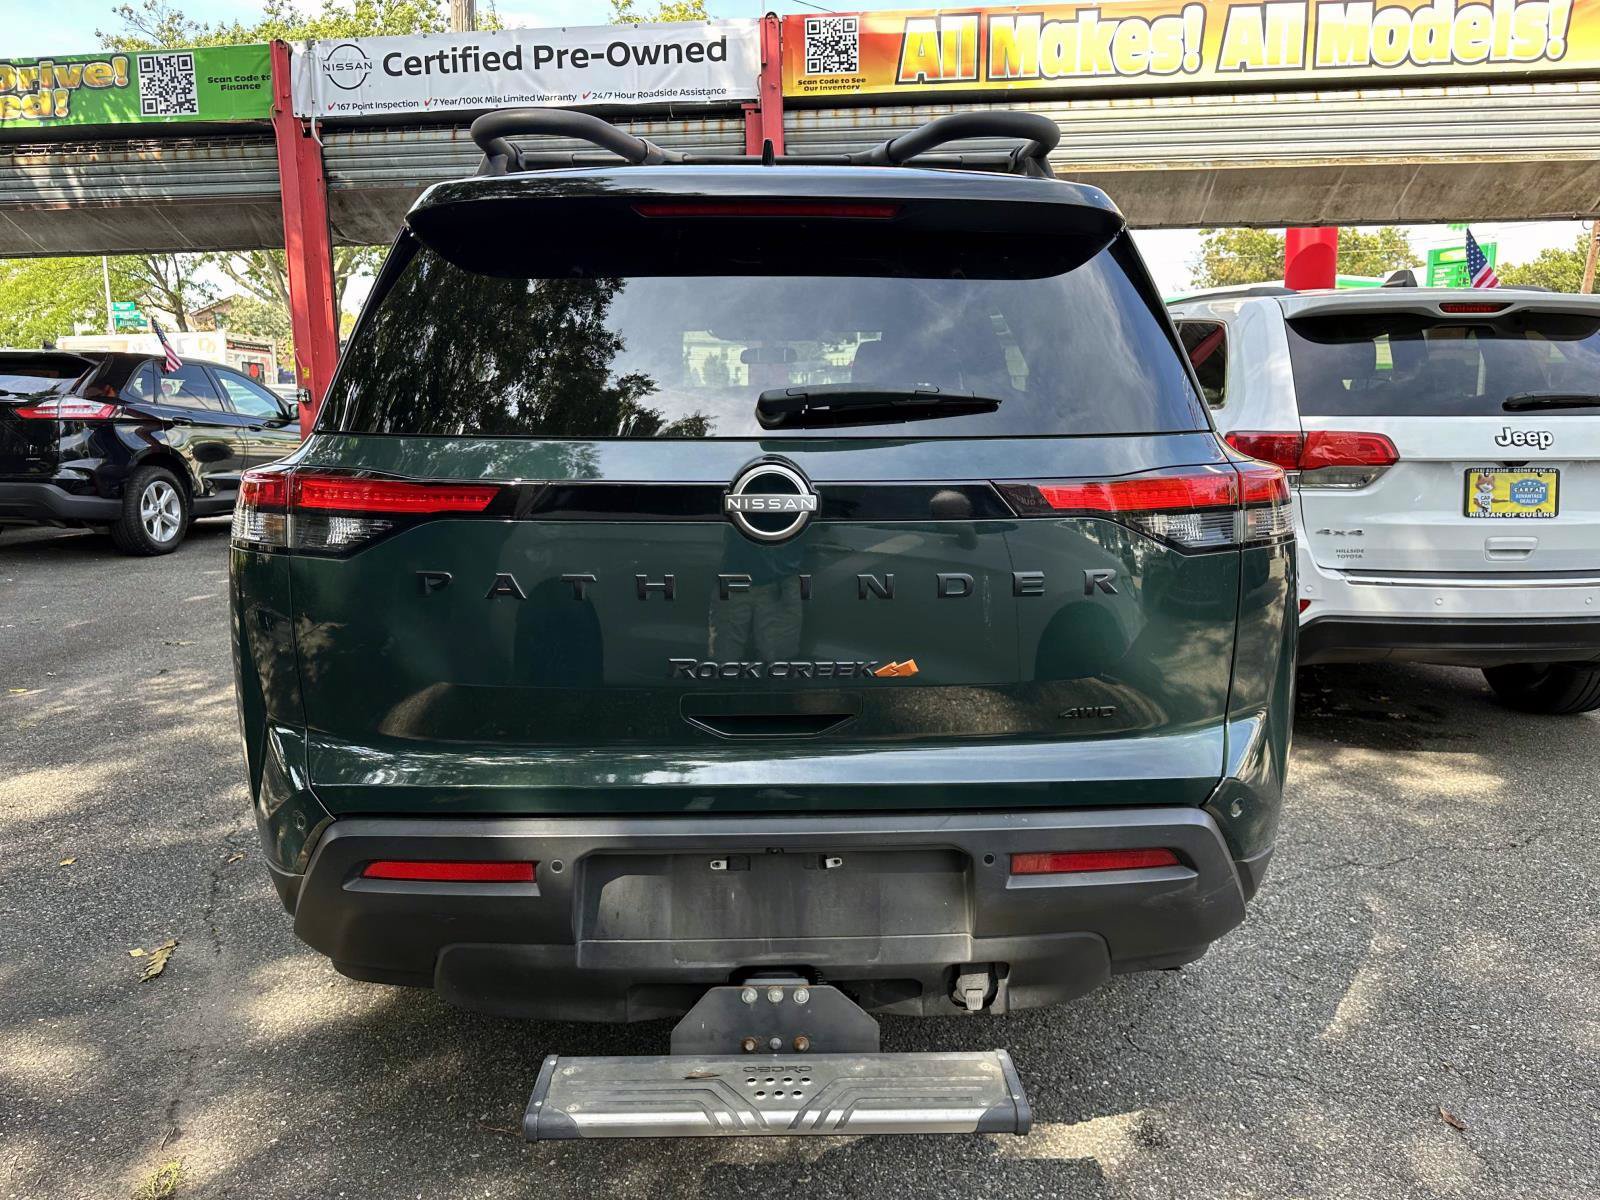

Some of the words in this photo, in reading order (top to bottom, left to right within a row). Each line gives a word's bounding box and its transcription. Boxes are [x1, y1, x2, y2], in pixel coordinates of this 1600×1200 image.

[896, 13, 980, 84] All
[986, 2, 1206, 82] Makes!
[1215, 1, 1308, 72] All
[1313, 0, 1573, 68] Models!
[382, 44, 523, 77] Certified
[533, 35, 727, 70] Pre-Owned
[322, 61, 373, 72] NISSAN
[207, 75, 232, 84] Scan
[234, 74, 259, 82] Code
[220, 83, 261, 91] Finance
[592, 92, 613, 100] 24/7
[614, 91, 636, 99] Hour
[637, 88, 678, 98] Roadside
[680, 87, 726, 97] Assistance
[336, 103, 350, 111] 167
[352, 102, 374, 110] Point
[375, 100, 419, 110] Inspection
[439, 96, 483, 106] Year/100K
[485, 96, 502, 104] Mile
[503, 94, 535, 103] Limited
[536, 93, 577, 102] Warranty
[1495, 426, 1554, 450] Jeep
[726, 497, 815, 510] NISSAN
[415, 568, 1119, 600] PATHFINDER
[668, 658, 763, 679] ROCK
[768, 661, 879, 679] CREEK
[1058, 705, 1117, 719] 4WD
